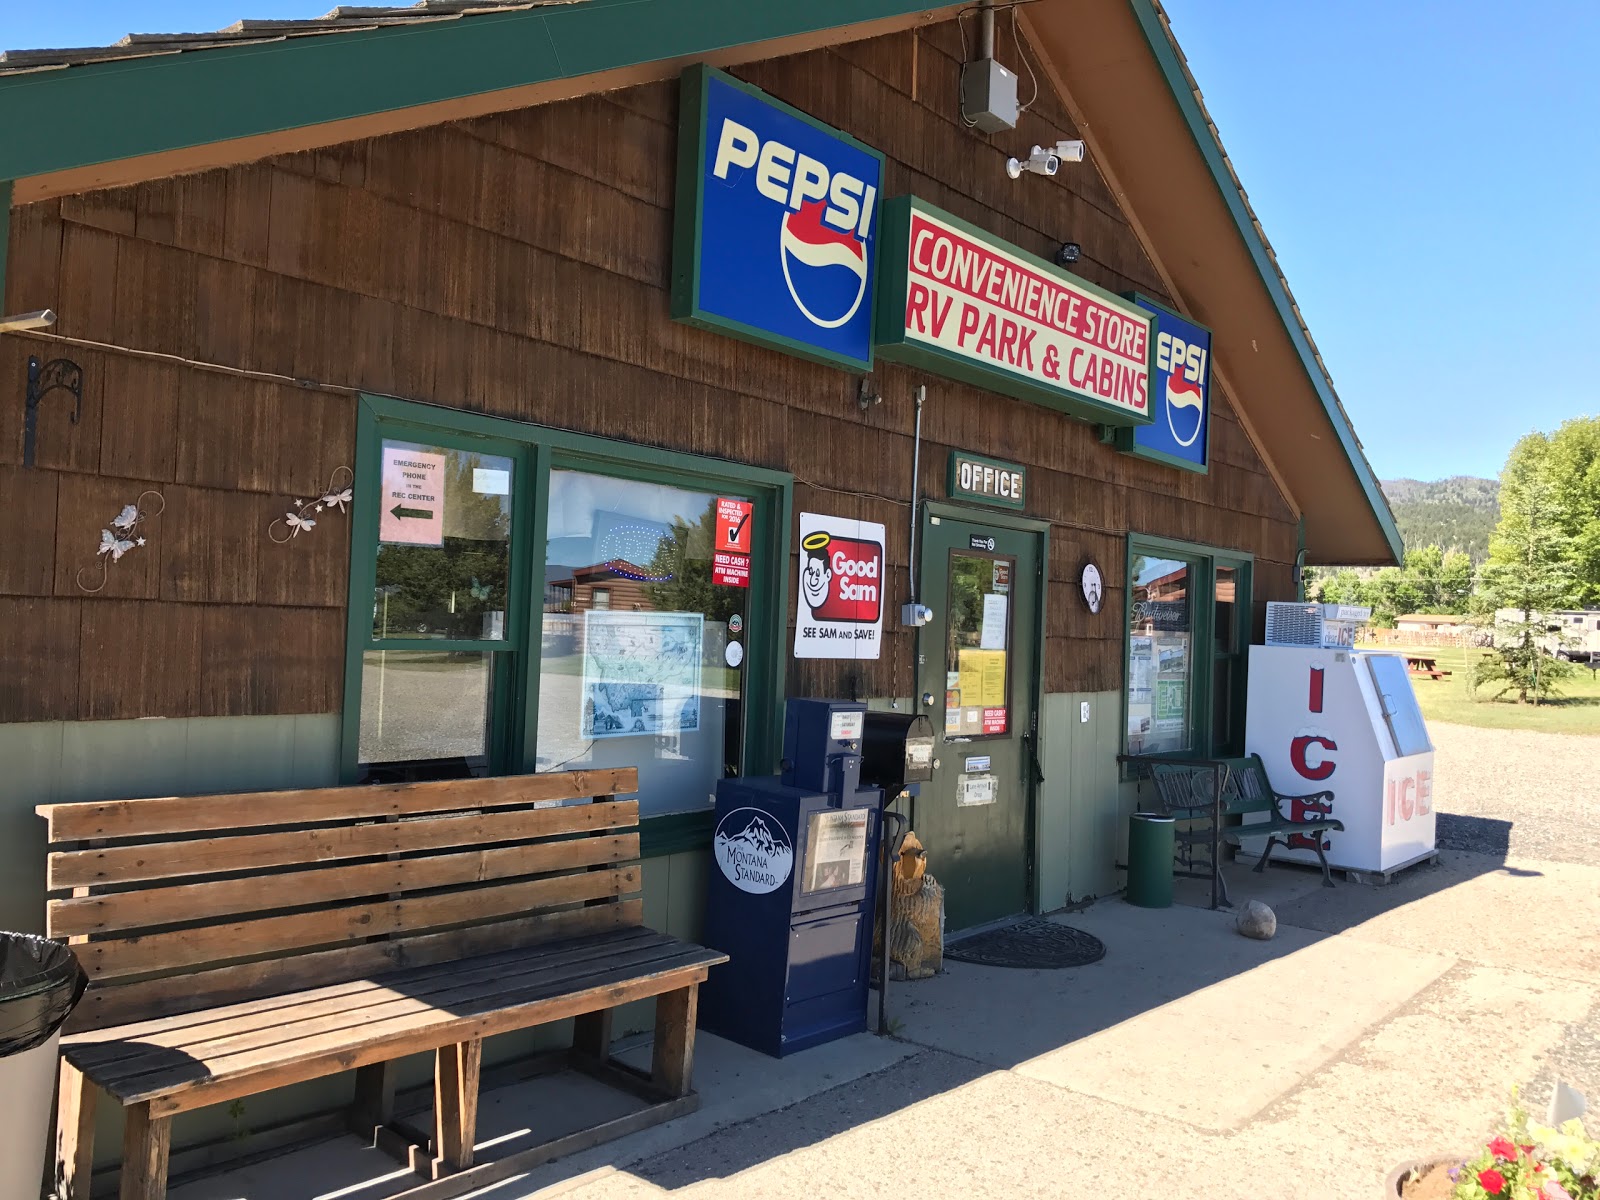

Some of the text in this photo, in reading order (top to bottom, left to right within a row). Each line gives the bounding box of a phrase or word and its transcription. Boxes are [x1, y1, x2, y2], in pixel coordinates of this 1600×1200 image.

[713, 118, 876, 238] PEPSI
[913, 228, 1146, 360] CONVENIENCE STORE
[906, 281, 1147, 409] RV PARK & CABINS
[1156, 331, 1207, 385] EPSI
[393, 459, 436, 470] EMERGENCY
[402, 472, 426, 480] PHONE
[960, 462, 1020, 498] OFFICE
[391, 491, 435, 501] REC CENTER
[718, 507, 743, 517] INSPECTED
[715, 554, 730, 564] NEED
[730, 556, 745, 566] CASH
[832, 551, 878, 578] Good
[715, 566, 749, 577] ATM MACHINE
[722, 575, 740, 584] INSIDE
[839, 576, 876, 602] Sam
[1132, 602, 1181, 622] Budweiser
[802, 626, 875, 640] SEE SAM AND SAVE!
[1337, 626, 1353, 646] ICE
[1387, 769, 1431, 827] ICE
[727, 845, 768, 869] MONTANA
[735, 863, 776, 886] STANDARD
